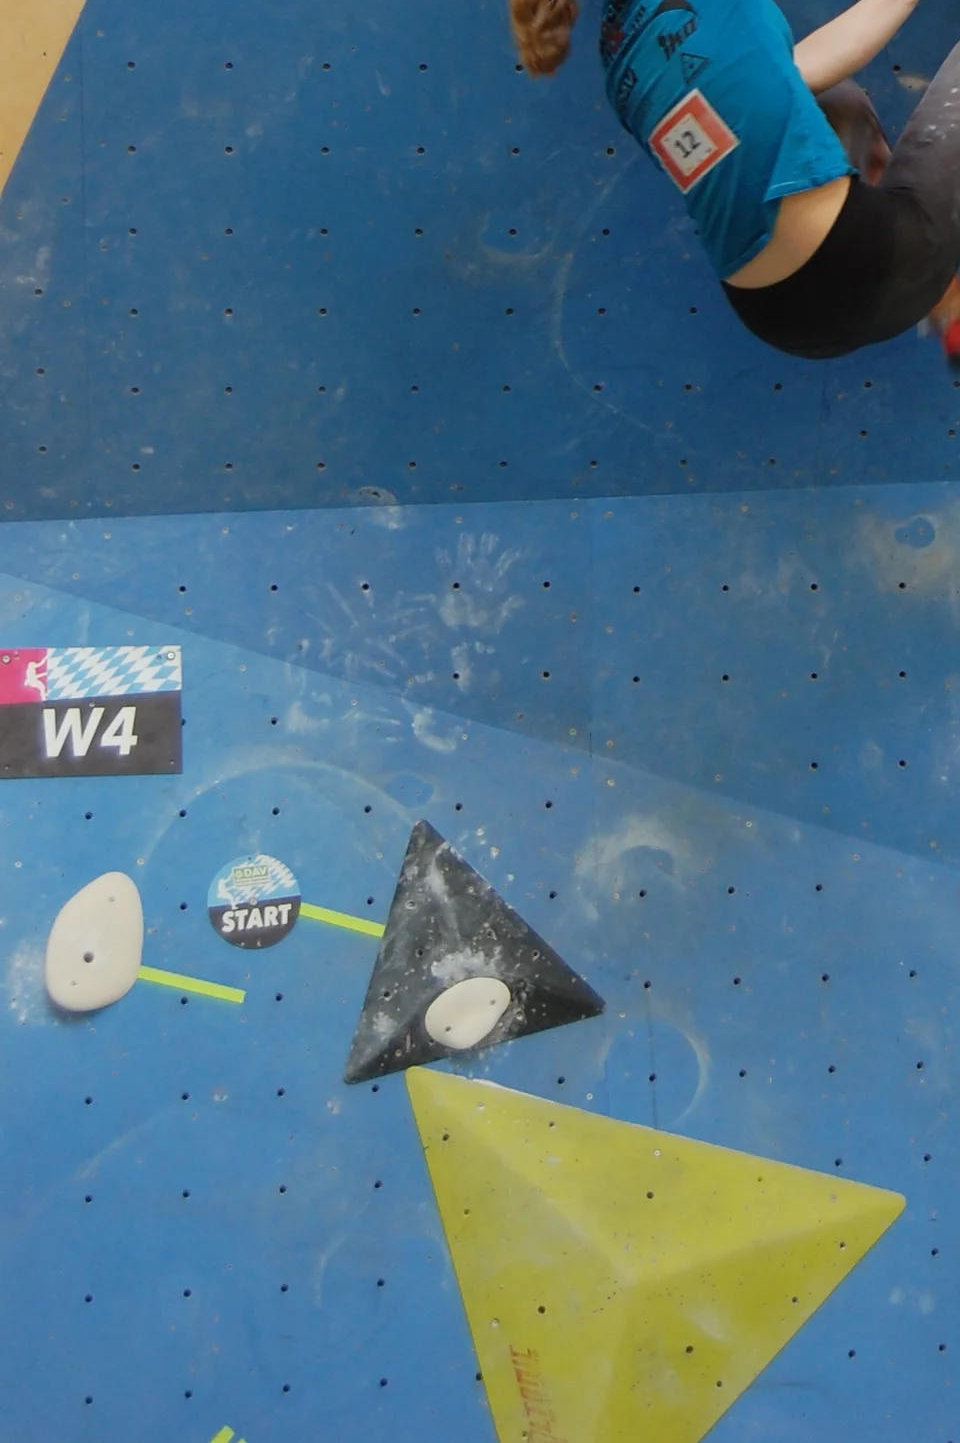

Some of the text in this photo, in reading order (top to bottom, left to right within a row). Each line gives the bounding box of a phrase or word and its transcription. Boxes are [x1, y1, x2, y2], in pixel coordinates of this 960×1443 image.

[674, 130, 701, 159] 12
[43, 706, 138, 758] W4
[243, 866, 268, 877] DAV
[222, 903, 292, 933] START
